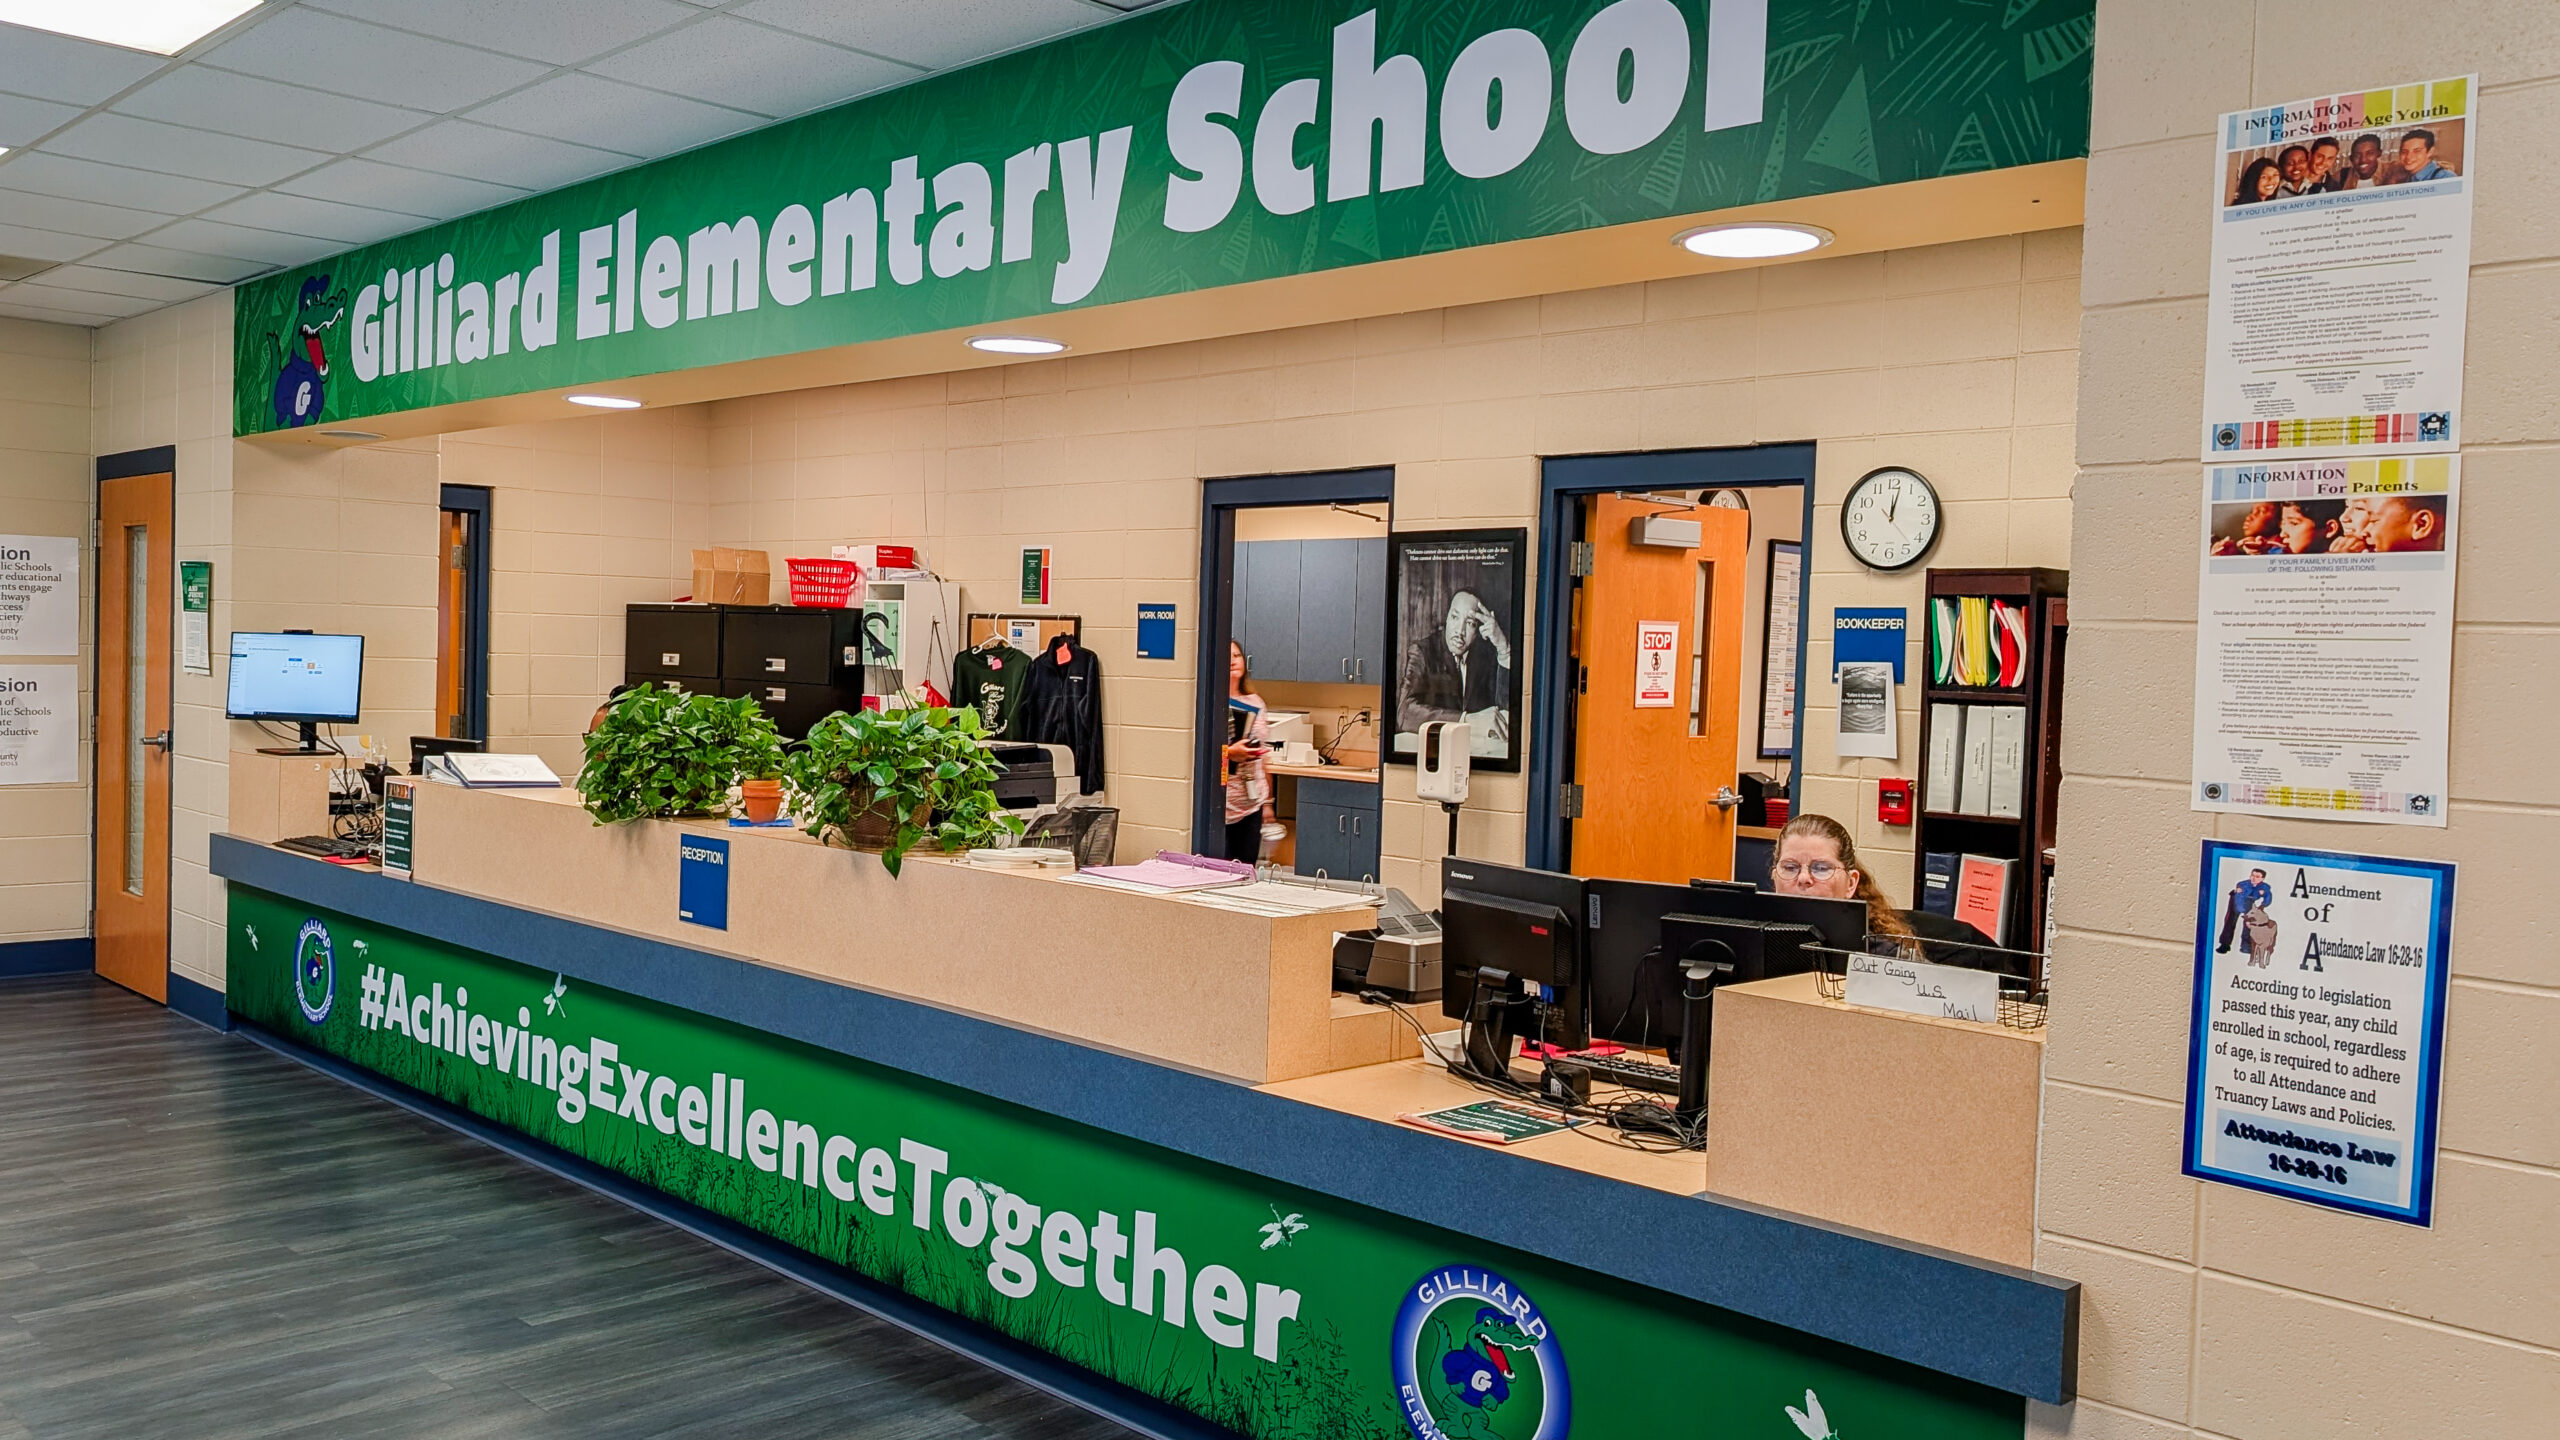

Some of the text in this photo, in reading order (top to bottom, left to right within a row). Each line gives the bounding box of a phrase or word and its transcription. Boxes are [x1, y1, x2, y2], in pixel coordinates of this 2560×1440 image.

[2244, 101, 2353, 130] INFORMATION
[2270, 104, 2449, 141] For School-Age Youth
[351, 0, 1768, 383] Gilliard Elementary School
[2245, 208, 2260, 216] YOU
[2262, 206, 2278, 214] LIVE
[2289, 202, 2305, 210] ANY
[2306, 200, 2316, 208] OF
[2336, 192, 2384, 203] FOLLOWING
[295, 381, 311, 416] G
[2238, 467, 2346, 485] INFORMATION
[2317, 481, 2419, 495] For Parents
[1853, 478, 1931, 560] 12 11 1 10 2 9 3 8 4 7 5 6
[5, 572, 62, 582] educational
[14, 562, 53, 571] Schools
[18, 584, 53, 593] engage
[1138, 611, 1175, 620] WORK ROOM
[1836, 618, 1905, 630] BOOKKEEPER
[1644, 633, 1671, 649] STOP
[14, 707, 52, 716] Schools
[681, 846, 724, 866] RECEPTION
[2290, 868, 2382, 901] Amendment
[2303, 903, 2334, 923] of
[300, 919, 331, 948] GILLIARD
[2299, 932, 2423, 973] Attendance Law 16-28-16
[1851, 957, 1917, 985] Out Going
[2231, 974, 2392, 1010] According to legislation
[1943, 1002, 1983, 1023] Mail
[2221, 997, 2398, 1035] passed this year, any child
[2212, 1021, 2406, 1061] enrolled in school, regardless
[2214, 1042, 2401, 1084] of age, is required to adhere
[2233, 1067, 2376, 1104] to all Attendance and
[2215, 1086, 2396, 1132] Truancy Laws and Policies.
[2223, 1119, 2396, 1168] Attendance Law
[361, 963, 1301, 1363] #AchievingExcellenceTogether
[2268, 1152, 2348, 1186] 16-28-16
[1418, 1269, 1547, 1341] GILLIARD
[1471, 1369, 1493, 1392] G
[1401, 1384, 1438, 1440] ELEM
